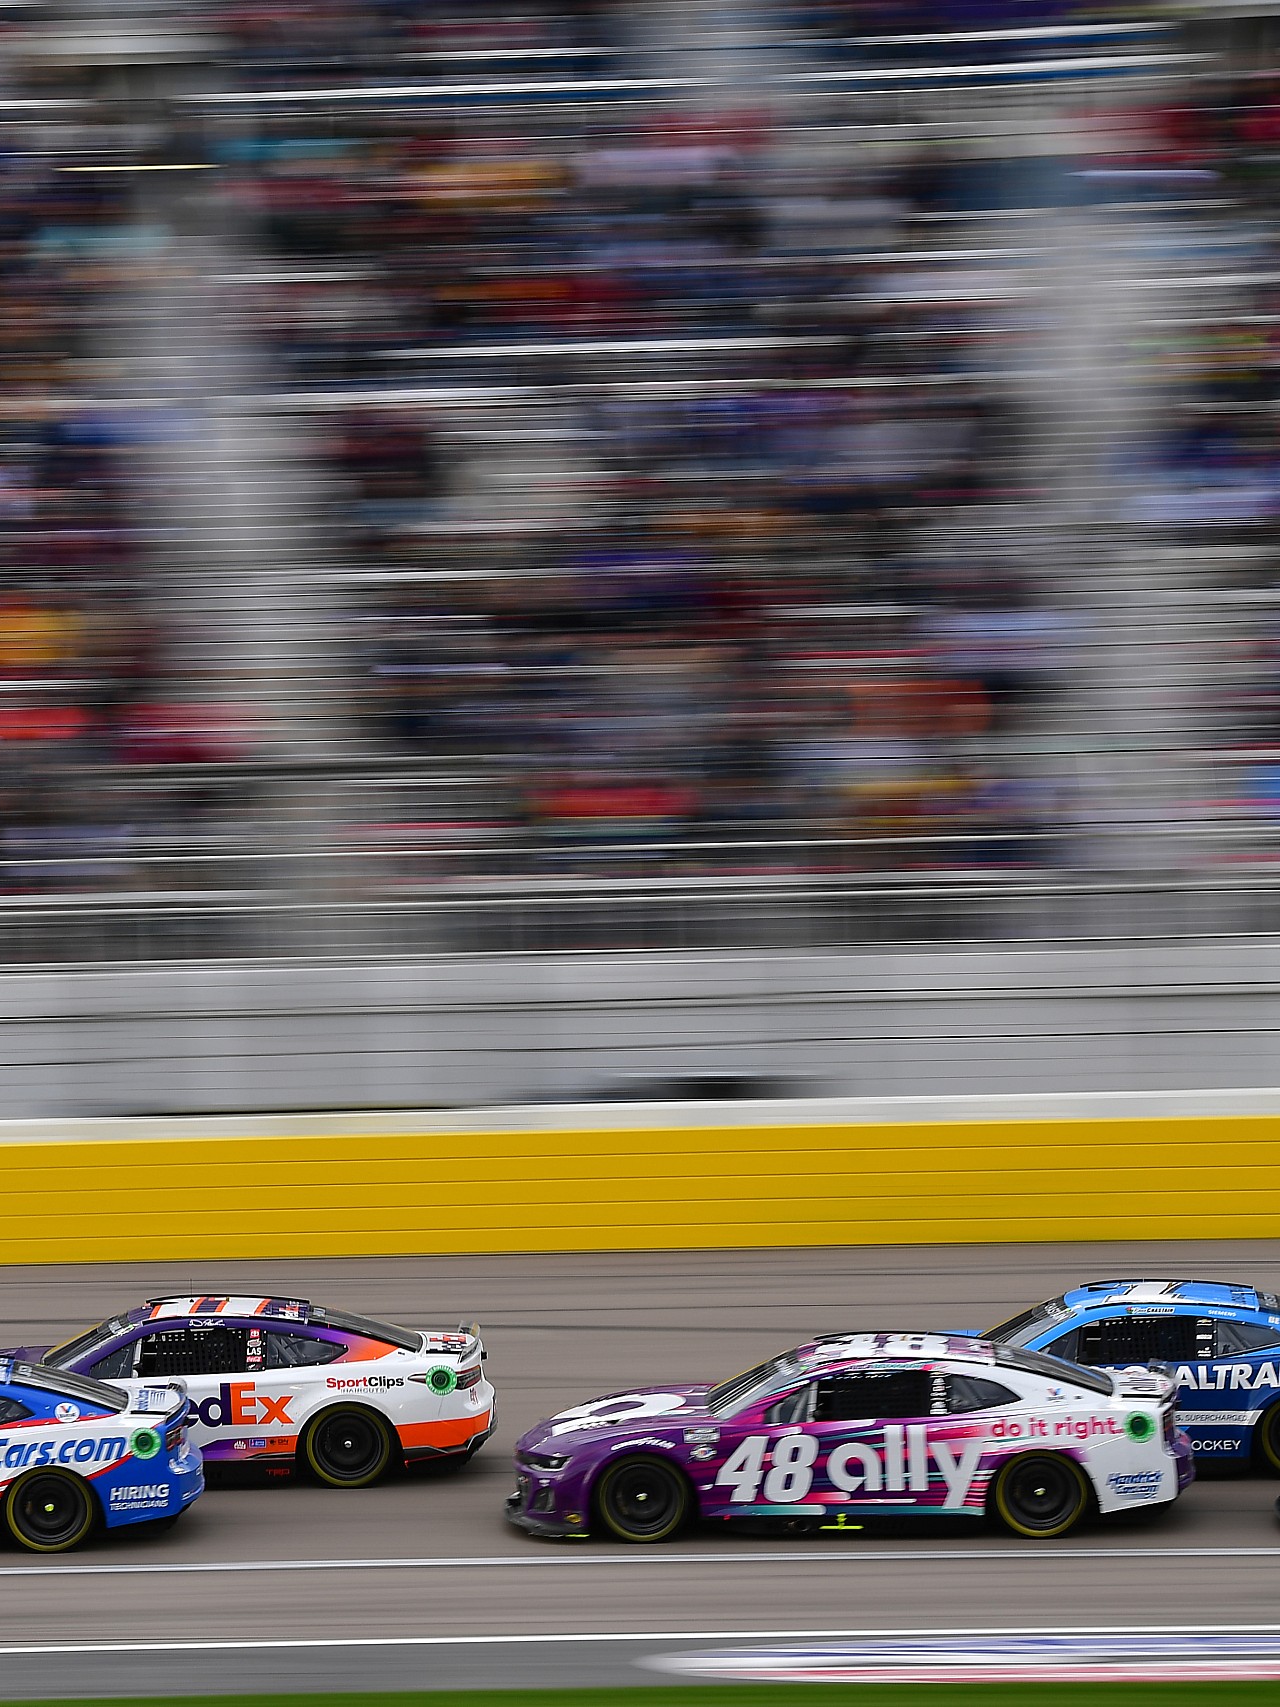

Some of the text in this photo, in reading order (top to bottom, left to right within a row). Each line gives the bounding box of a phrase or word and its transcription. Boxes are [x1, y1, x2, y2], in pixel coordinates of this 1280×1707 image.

[1208, 1309, 1237, 1317] SIEMENS
[326, 1376, 405, 1390] SportClips
[1173, 1362, 1280, 1390] ALTRA
[187, 1382, 295, 1428] dEx
[992, 1419, 1022, 1437] do
[1029, 1417, 1048, 1436] it
[1191, 1440, 1242, 1451] OCKEY
[714, 1434, 819, 1503] 48
[826, 1425, 981, 1509] ally
[110, 1484, 169, 1501] HIRING
